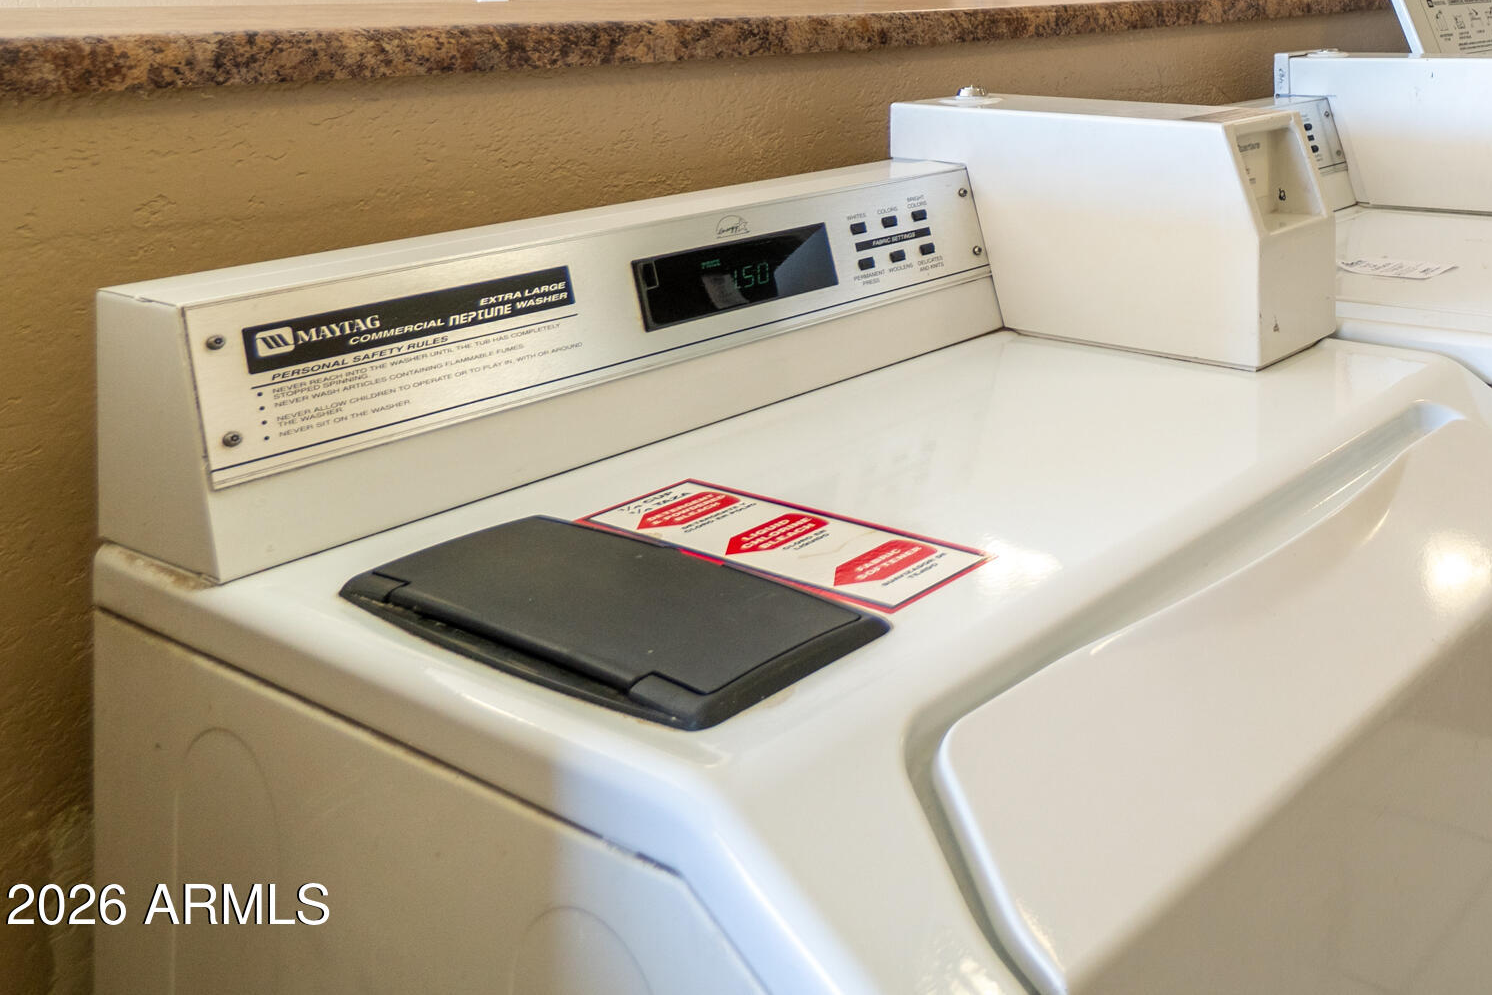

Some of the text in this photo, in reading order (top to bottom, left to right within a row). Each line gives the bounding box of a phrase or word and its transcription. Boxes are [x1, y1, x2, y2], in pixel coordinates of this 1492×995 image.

[877, 207, 898, 215] COLORS
[907, 201, 927, 209] COLORS
[847, 213, 866, 221] WHITES
[872, 232, 916, 246] FABRIC SETTINGS
[888, 263, 913, 272] WOOLENS
[918, 255, 943, 266] DELICATES
[854, 269, 885, 281] PERMANENT
[480, 282, 566, 306] EXTRA LARGE
[297, 315, 381, 344] MAYTAG
[349, 292, 568, 345] COMMERCIAL NEPTUNE WASHER
[271, 336, 449, 381] PERSONAL SAFETY RULES
[272, 383, 307, 393] NEVER
[309, 374, 343, 385] REACH
[345, 368, 368, 377] INTO
[371, 363, 389, 371] THE
[390, 353, 428, 368] WASHER
[475, 339, 491, 347] TUB
[493, 335, 509, 343] HAS
[510, 323, 561, 341] COMPLETELY
[275, 395, 309, 408] NEVER
[311, 388, 340, 400] WASH
[342, 377, 387, 392] ARTICLES
[389, 362, 444, 381] CONTAINING
[445, 351, 494, 366] FLAMMABLE
[277, 409, 311, 422] NEVER
[314, 400, 347, 412] ALLOW
[350, 388, 397, 404] CHILDREN
[399, 383, 410, 391] TO
[412, 375, 454, 388] OPERATE
[482, 362, 503, 372] PLAY
[516, 354, 536, 362] WITH
[551, 342, 583, 353] AROUND
[274, 384, 320, 399] STOPPED
[278, 418, 298, 427] THE
[279, 424, 314, 437] NEVER
[316, 420, 330, 428] SIT
[333, 415, 348, 423] ON
[351, 410, 369, 419] THE
[643, 491, 673, 504] CUP
[646, 494, 714, 522] DETERGENT
[655, 492, 692, 506] TAZA
[664, 494, 726, 520] POWDERED
[673, 502, 721, 522] BLEACH
[740, 517, 813, 550] CHLORINE
[741, 519, 790, 541] LIQUID
[758, 523, 816, 549] BLEACH
[855, 549, 901, 572] FABRIC
[855, 546, 922, 580] SOFTENER
